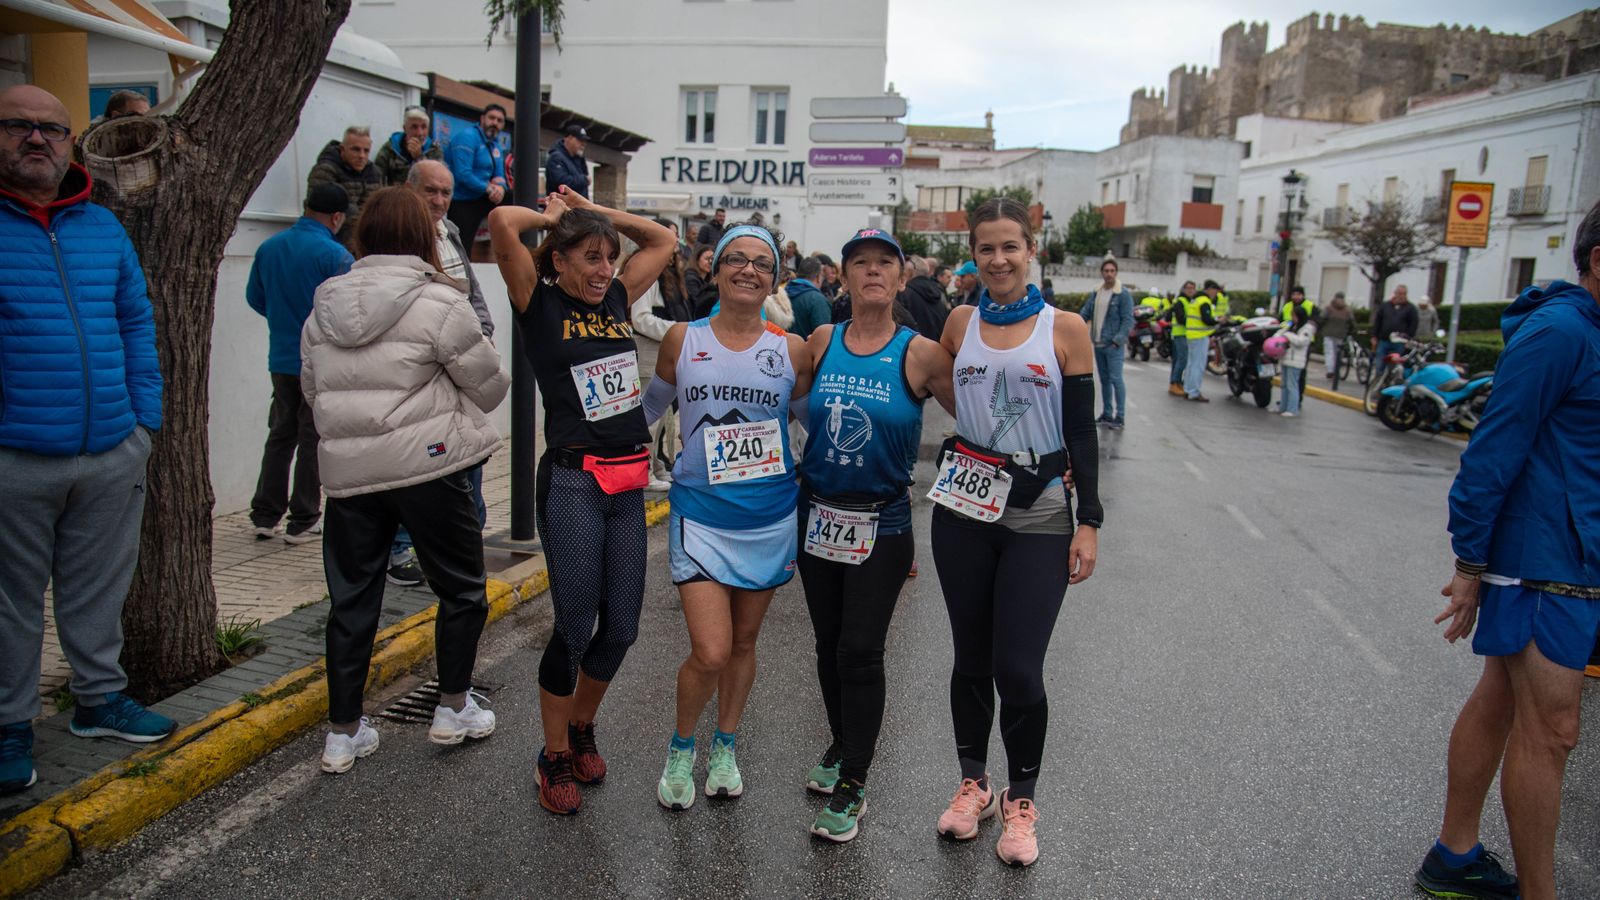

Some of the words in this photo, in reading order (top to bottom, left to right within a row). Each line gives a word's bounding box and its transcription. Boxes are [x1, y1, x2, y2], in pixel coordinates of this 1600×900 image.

[661, 156, 805, 186] FREIDURIA
[812, 178, 835, 186] Casco
[700, 195, 713, 209] LA
[813, 191, 865, 200] Ayuntamiento
[585, 362, 607, 378] XIV
[603, 371, 626, 396] 62
[821, 373, 891, 391] MEMORIAL
[958, 377, 969, 387] UP
[685, 384, 708, 403] LOS
[712, 385, 780, 408] VEREITAS
[717, 428, 741, 440] XIV
[725, 437, 763, 462] 240
[956, 455, 977, 469] XIV
[953, 469, 991, 499] 488
[818, 508, 838, 521] XIV
[837, 513, 862, 521] CARRERA
[821, 521, 857, 545] 474
